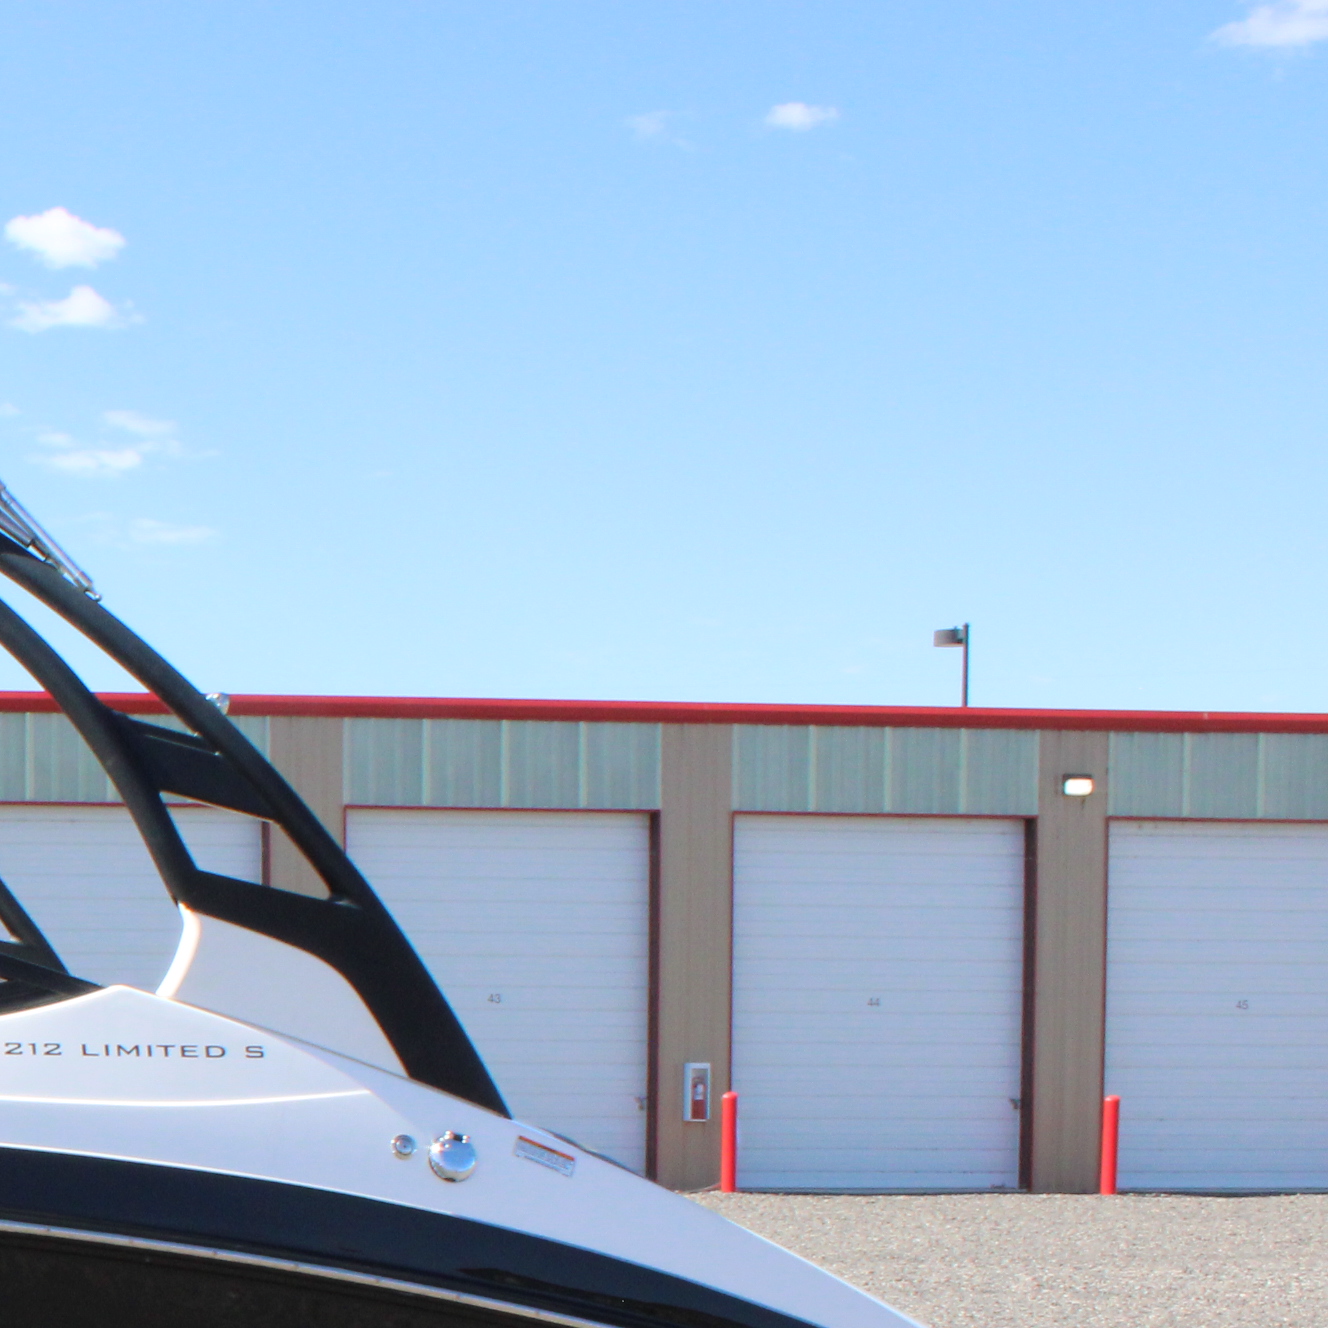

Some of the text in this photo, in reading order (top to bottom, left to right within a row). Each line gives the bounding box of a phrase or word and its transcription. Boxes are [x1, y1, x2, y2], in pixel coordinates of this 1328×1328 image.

[4, 1042, 265, 1059] 212 LIMITED S
